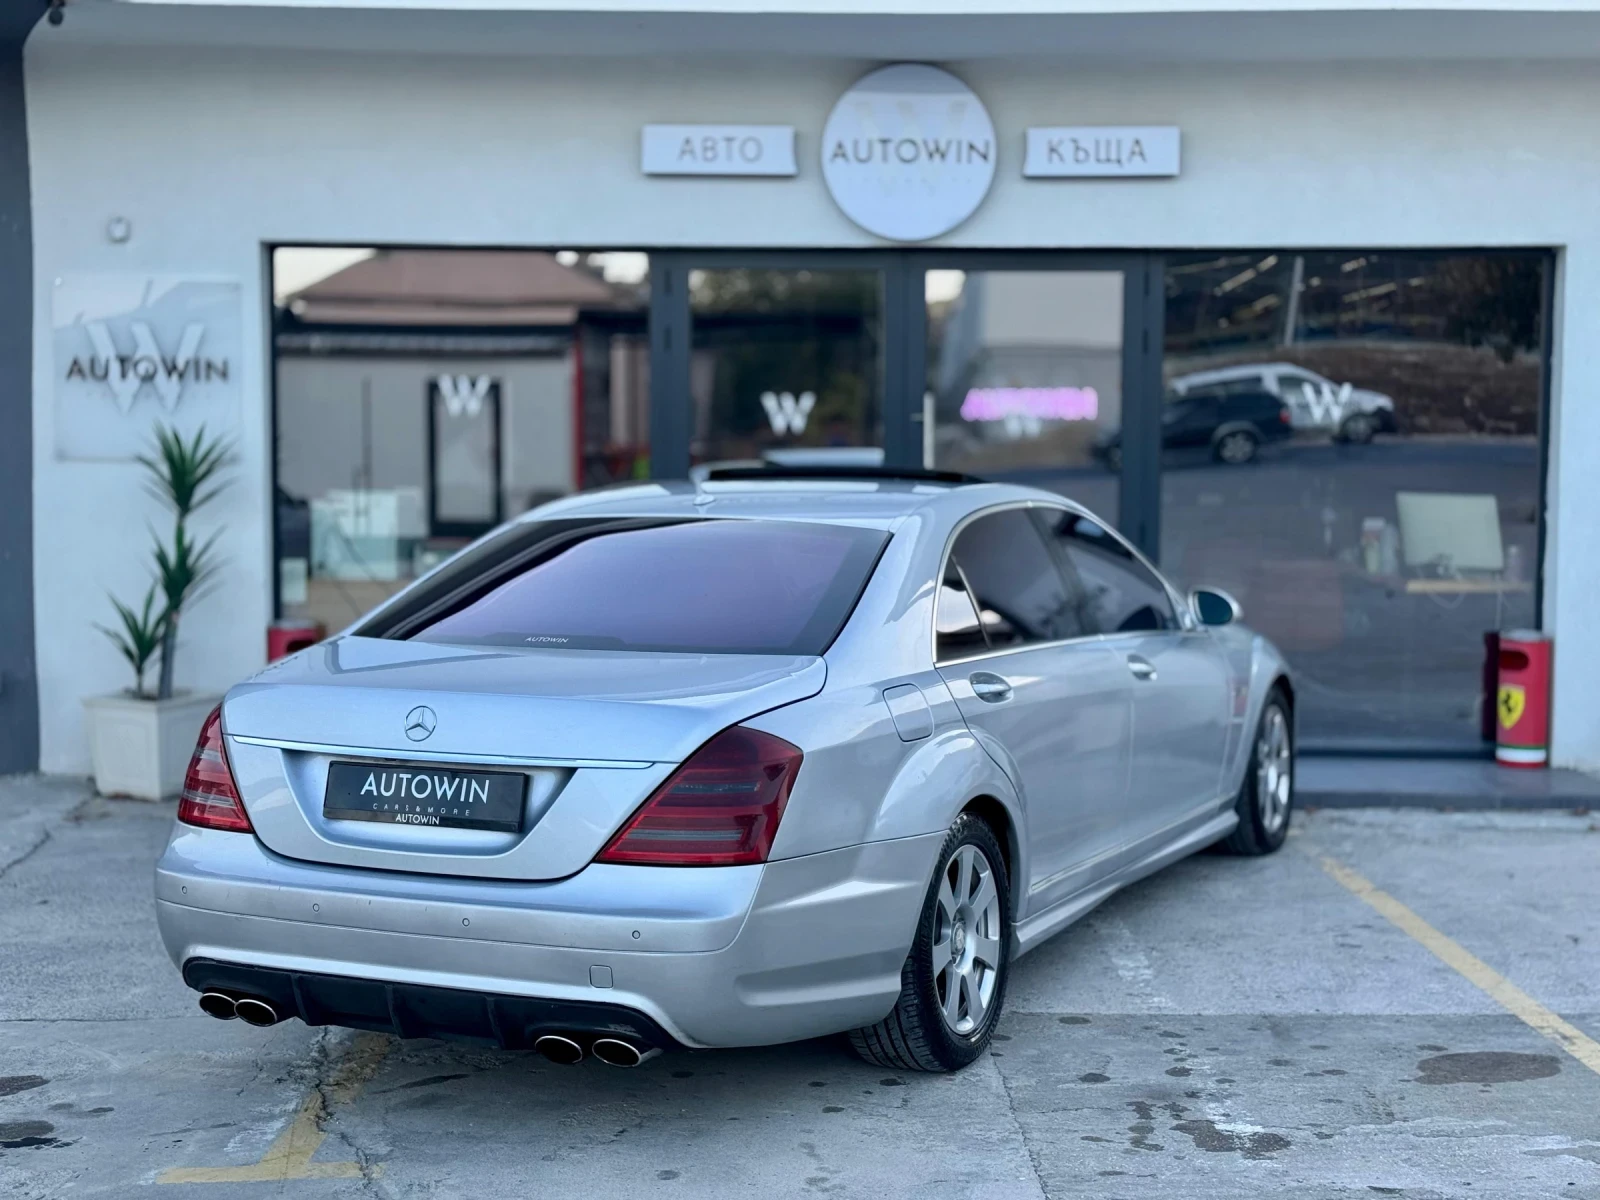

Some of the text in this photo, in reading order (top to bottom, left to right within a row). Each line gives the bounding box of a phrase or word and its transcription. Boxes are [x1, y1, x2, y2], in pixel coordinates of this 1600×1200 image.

[677, 135, 763, 162] АВТО
[830, 138, 991, 164] AUTOWIN
[1046, 136, 1148, 168] КЪЩА
[66, 355, 229, 382] AUTOWIN
[86, 320, 204, 416] W
[436, 373, 491, 416] W
[1302, 381, 1353, 424] W
[760, 391, 816, 435] W
[360, 772, 490, 804] AUTOWIN
[395, 813, 440, 825] AUTOWIN
